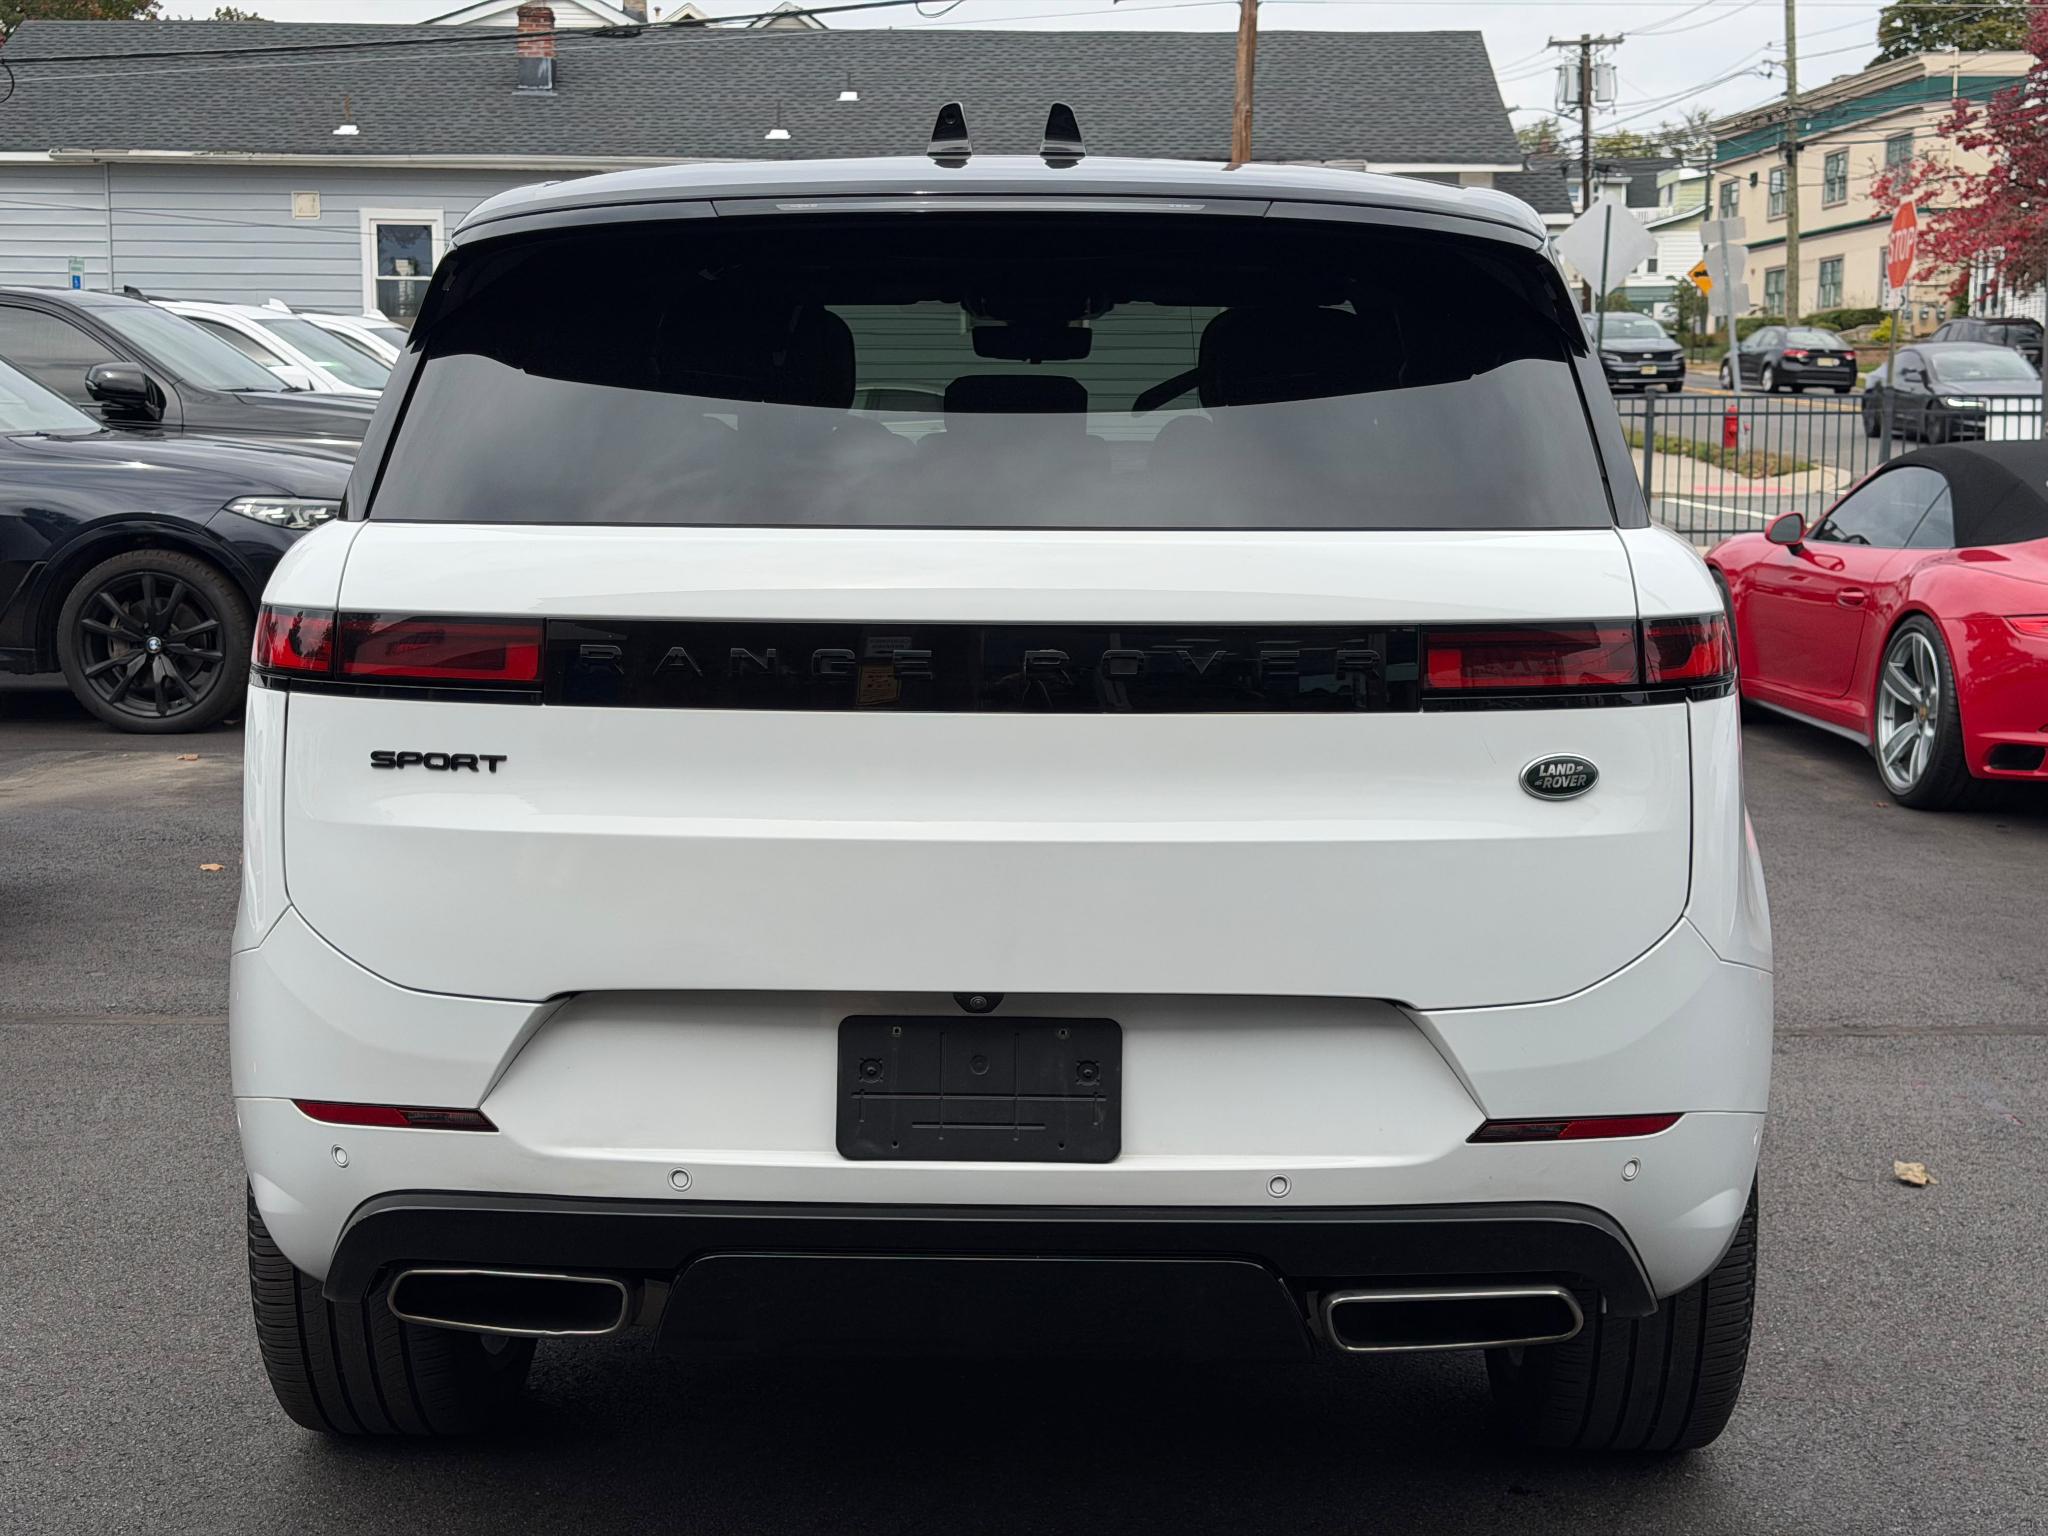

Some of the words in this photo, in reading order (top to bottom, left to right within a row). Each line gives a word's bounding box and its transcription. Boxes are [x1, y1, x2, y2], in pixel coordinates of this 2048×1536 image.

[1888, 226, 1915, 264] STOP
[579, 644, 934, 681] RANGE
[1023, 648, 1382, 682] ROVER
[370, 750, 507, 773] SPORT
[1539, 763, 1576, 777] LAND
[1542, 774, 1587, 788] ROVER
